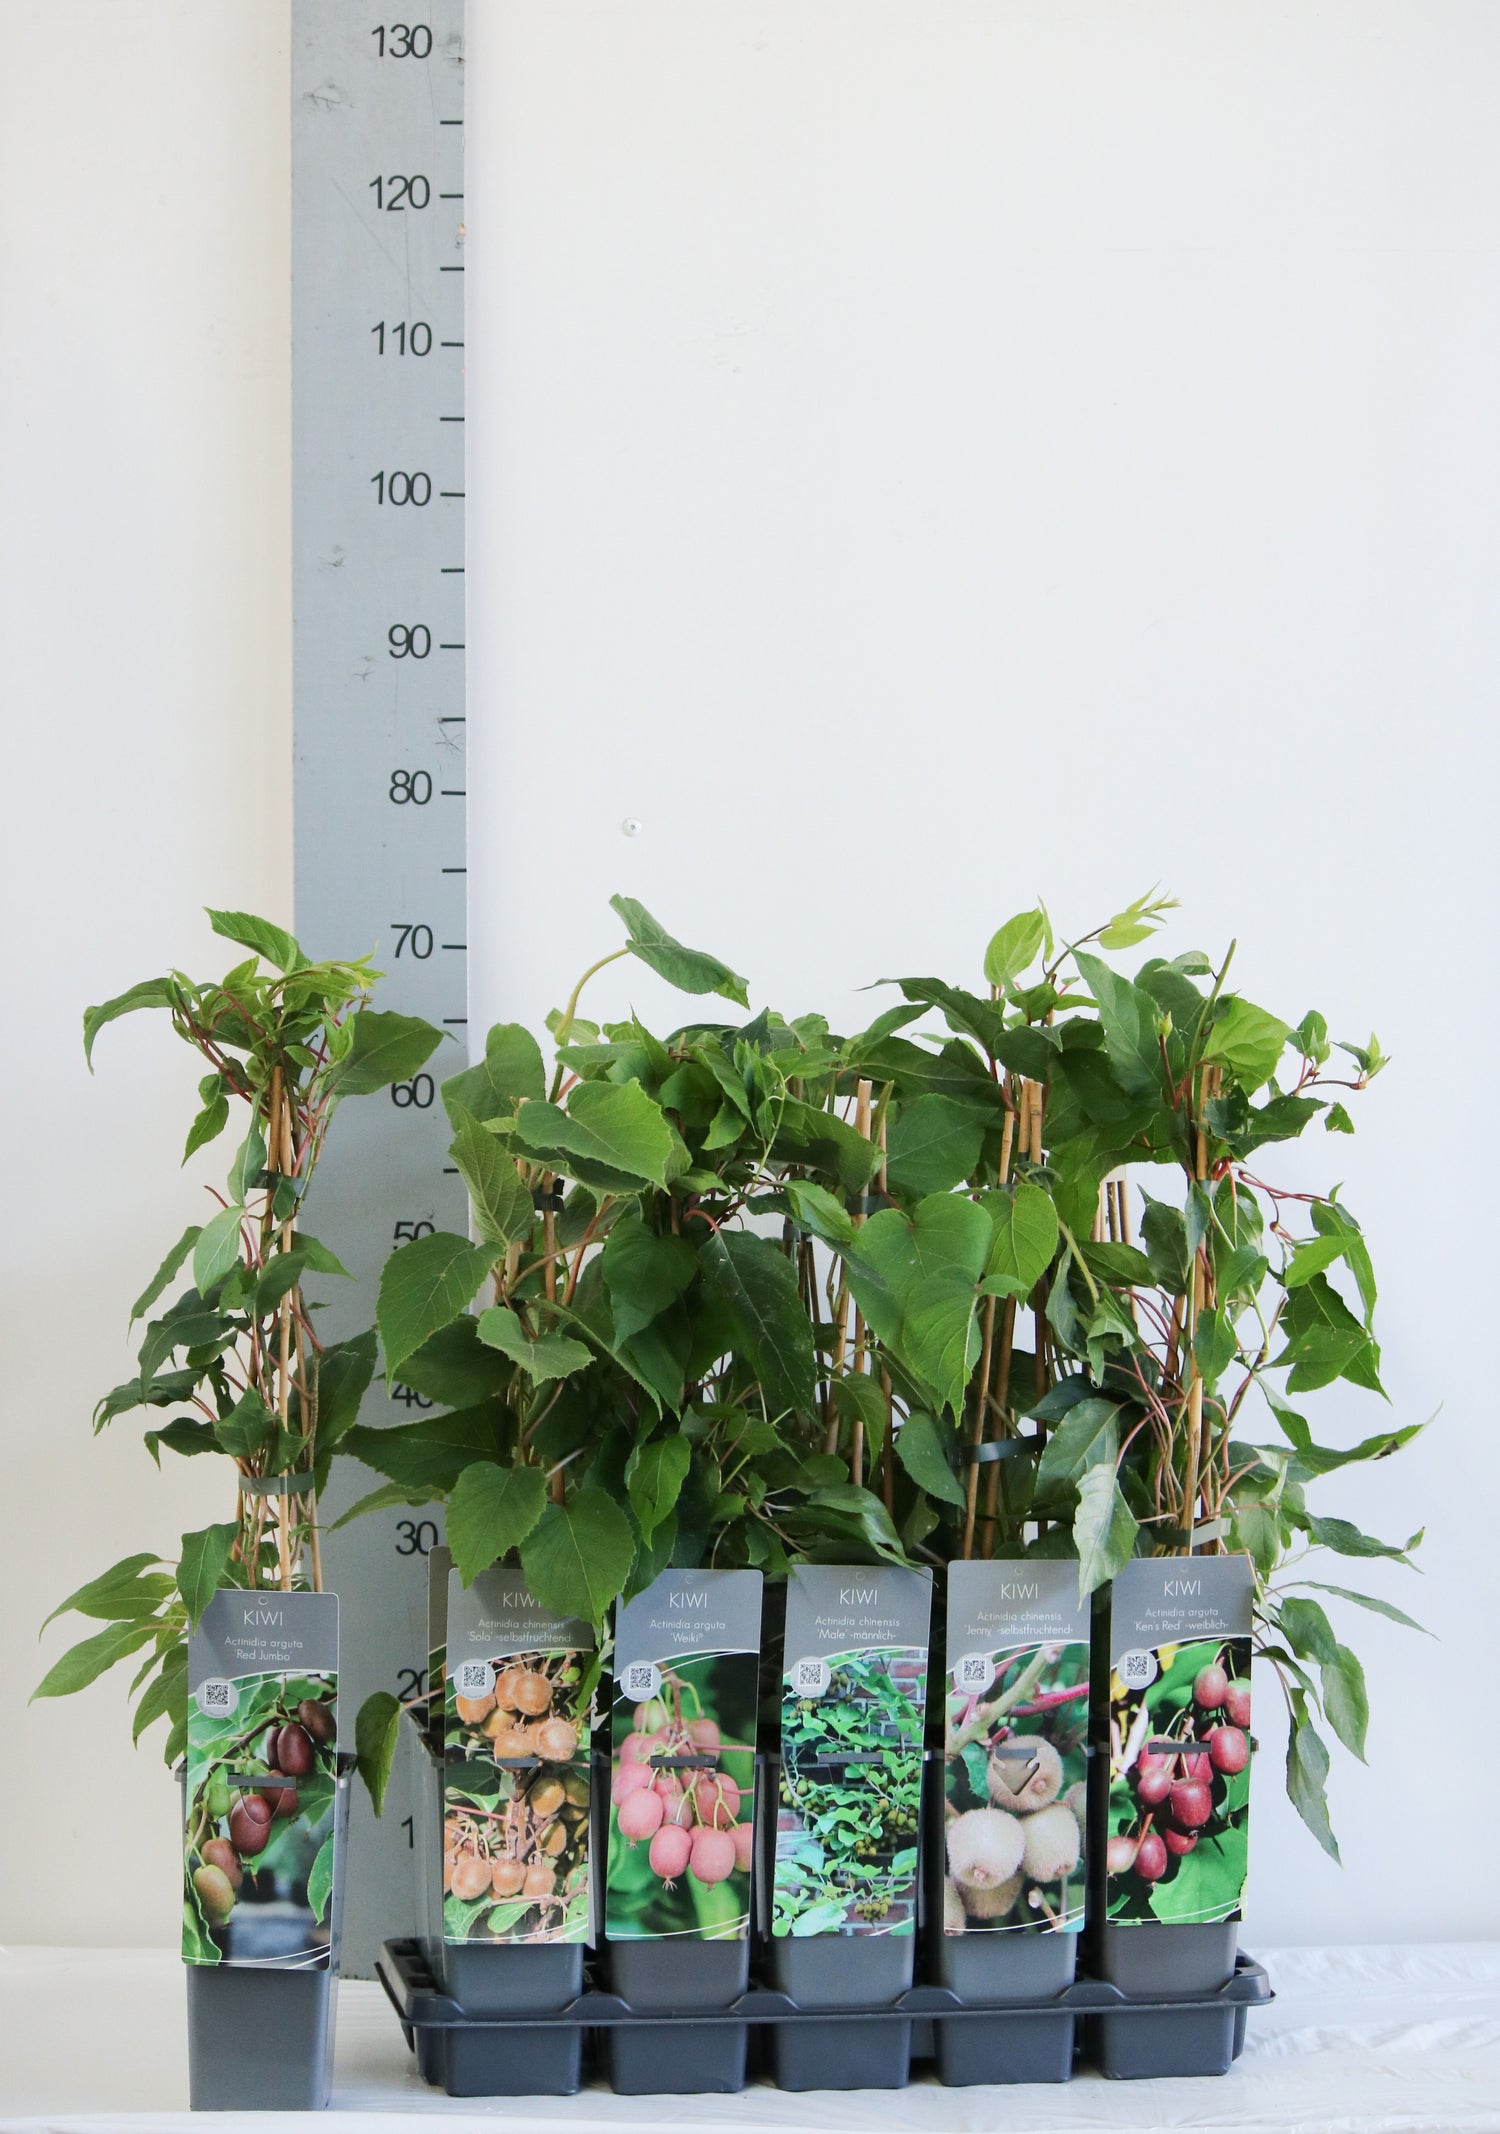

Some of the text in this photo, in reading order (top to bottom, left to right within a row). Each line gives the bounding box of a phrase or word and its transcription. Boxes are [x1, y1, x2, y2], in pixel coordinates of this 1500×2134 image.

[371, 23, 433, 59] 130
[369, 174, 431, 212] 120
[371, 320, 433, 357] 110
[370, 470, 432, 507] 100
[388, 623, 432, 660] 90
[388, 769, 433, 806] 80
[390, 924, 434, 960] 70
[391, 1074, 434, 1108] 60
[395, 1520, 438, 1556] 30
[839, 1588, 878, 1605] KIWI
[1001, 1583, 1038, 1600] KIWI
[1164, 1580, 1201, 1597] KIWI
[669, 1592, 708, 1609] KIWI
[243, 1609, 284, 1627] KIWI
[815, 1615, 901, 1627] Actinidia chinensis
[977, 1611, 1062, 1621] Actinidia chinensis
[1145, 1608, 1219, 1618] Actinidia arguta
[478, 1619, 565, 1630] Actinidia chinensis
[650, 1619, 726, 1631] Actinidia arguta
[224, 1635, 303, 1650] Actinidia arguta
